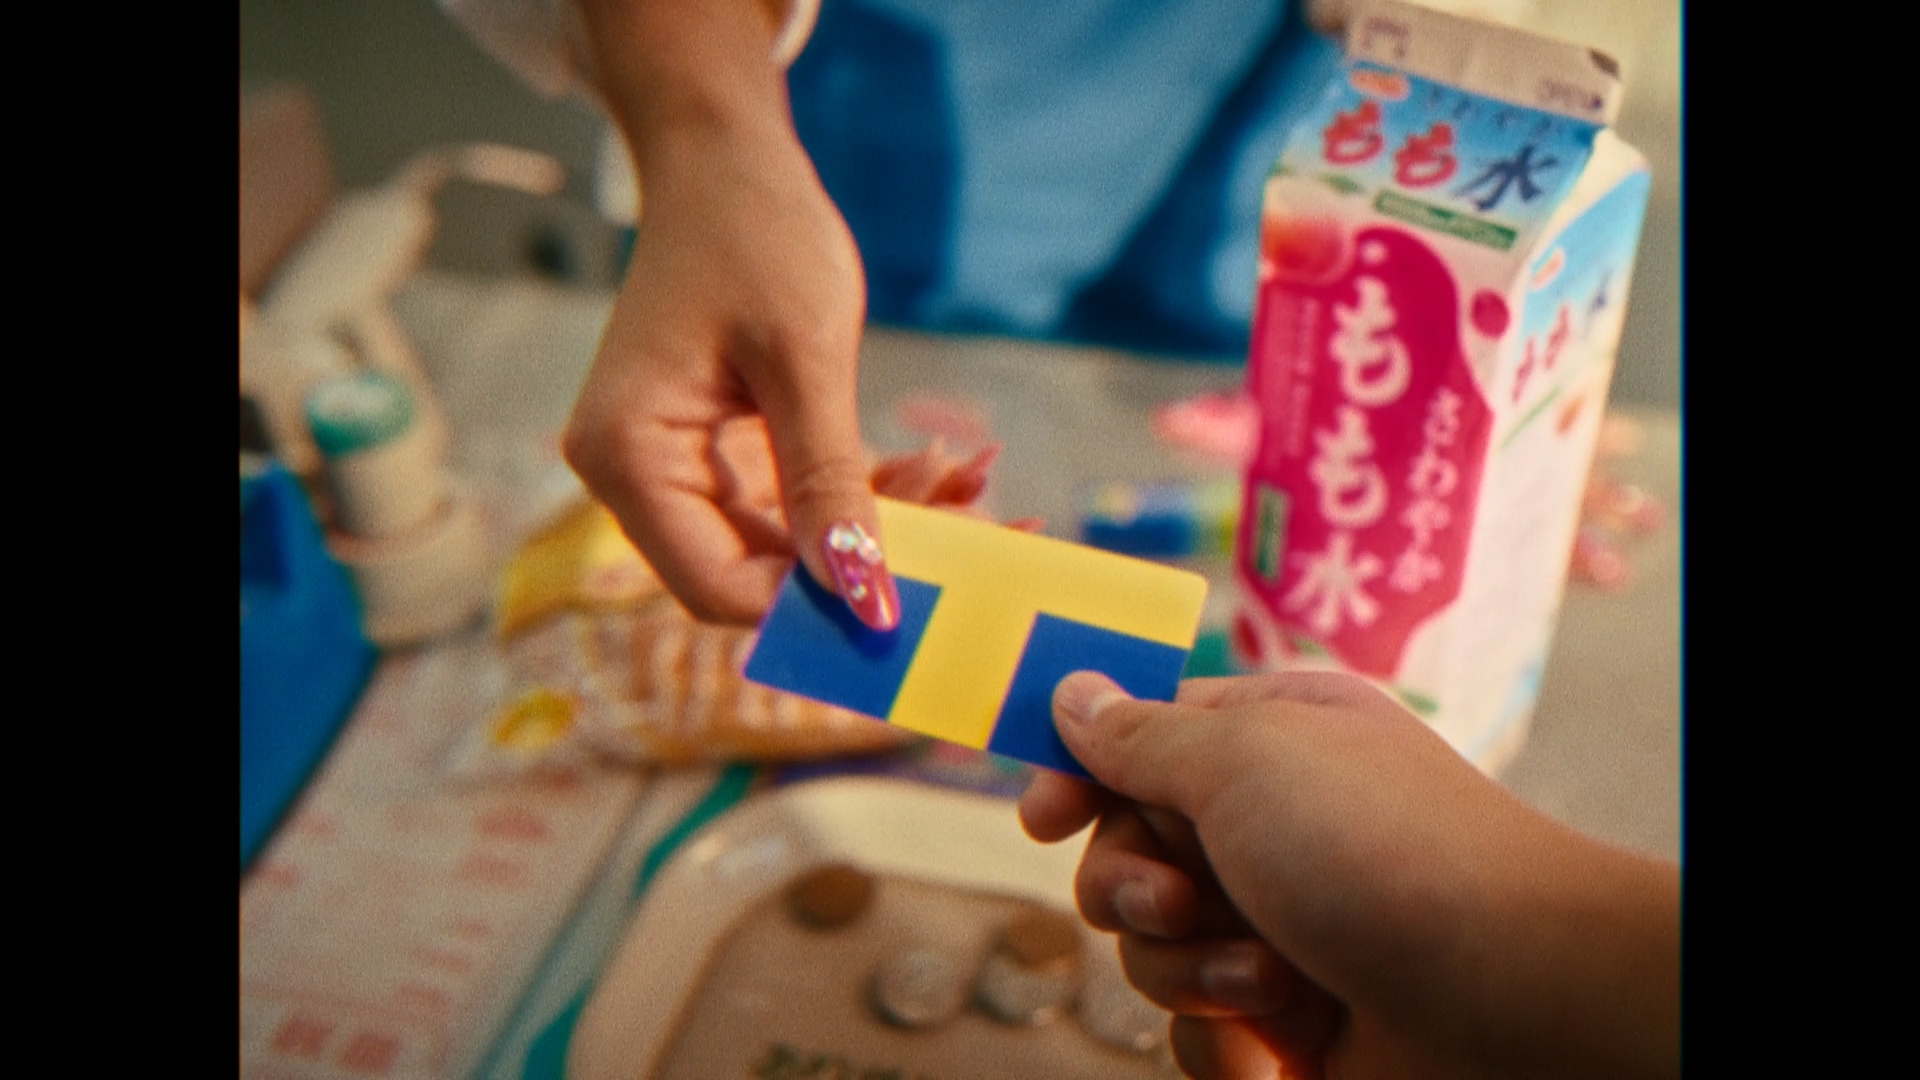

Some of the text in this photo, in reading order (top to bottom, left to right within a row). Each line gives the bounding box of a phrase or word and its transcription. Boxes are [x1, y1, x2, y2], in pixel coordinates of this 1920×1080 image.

[1321, 100, 1559, 213] もも水
[1284, 274, 1413, 638] もも水
[1387, 385, 1462, 594] さわやか
